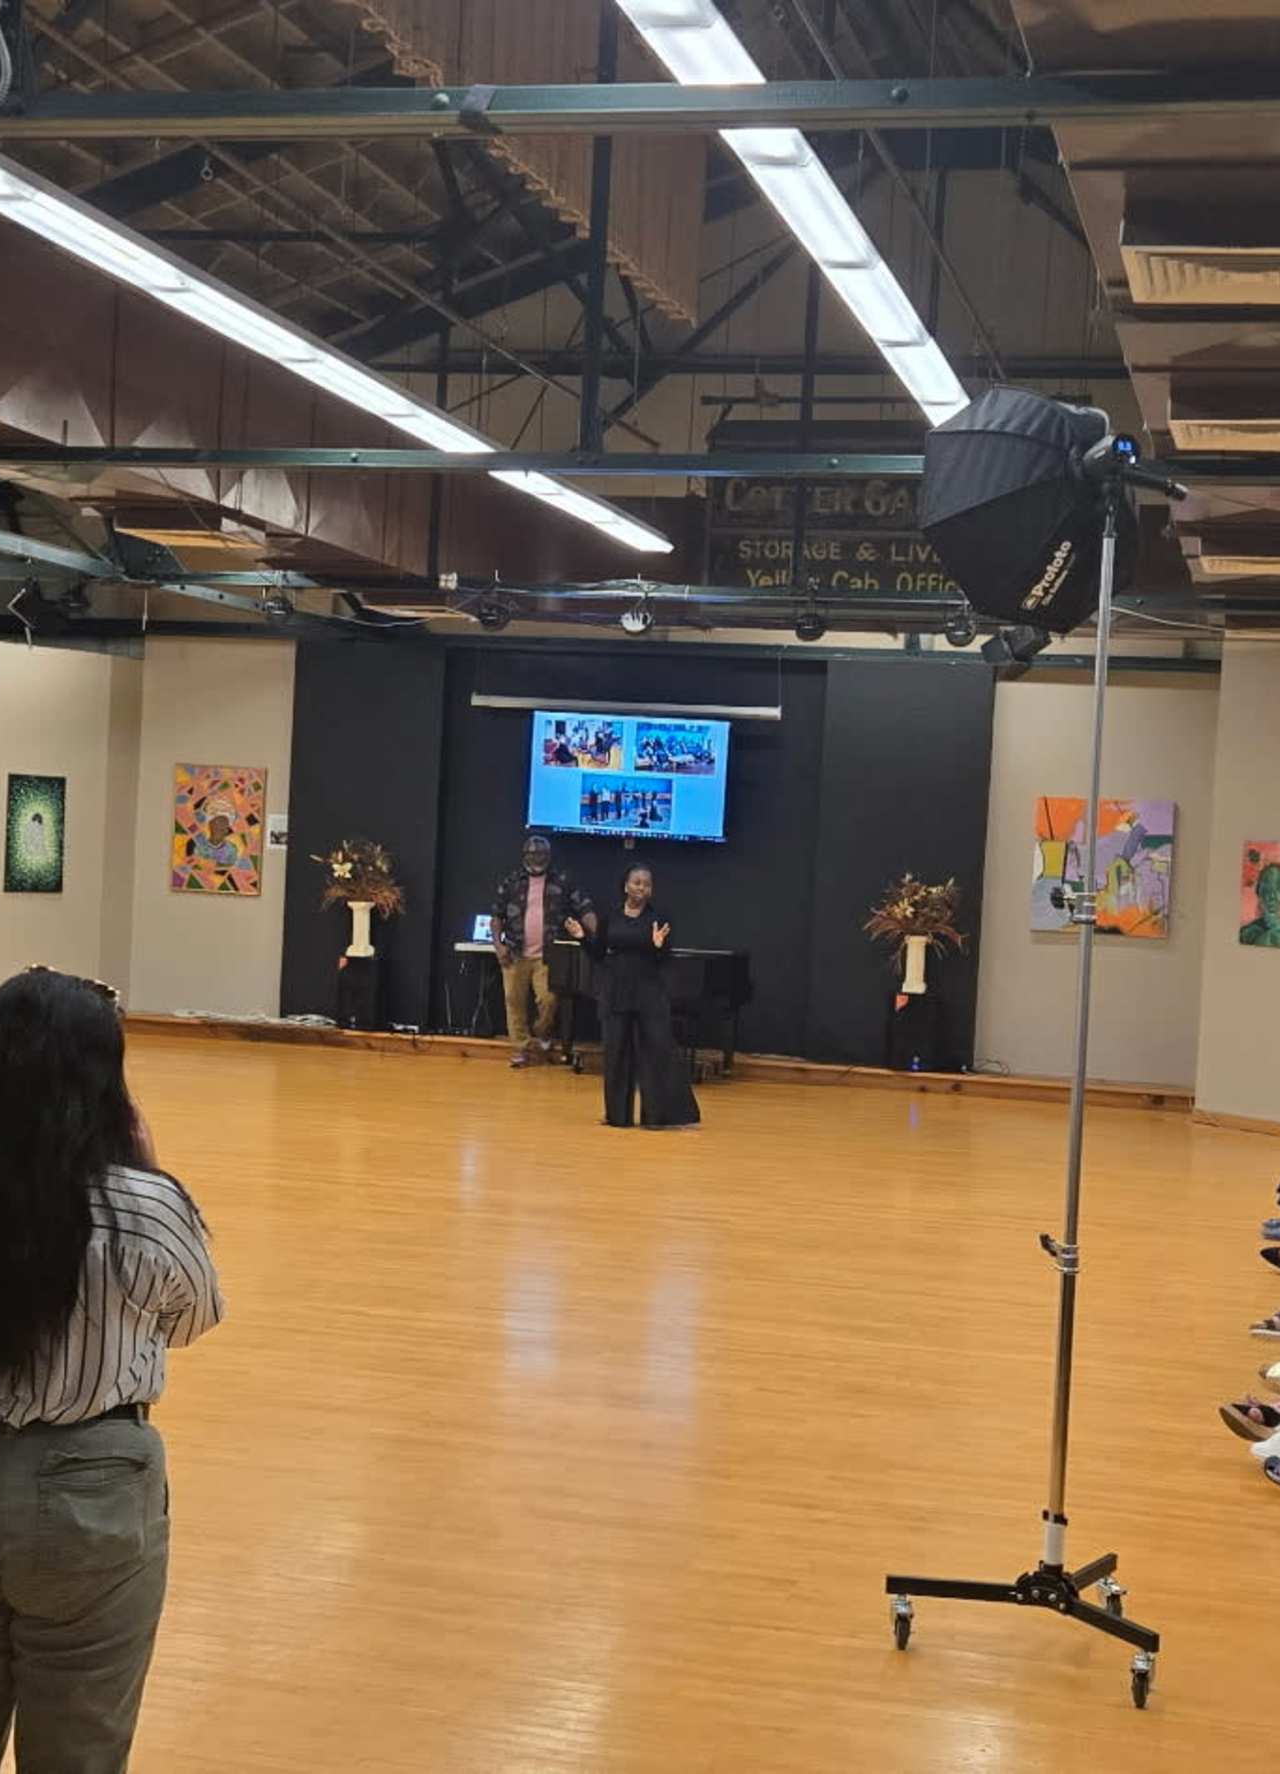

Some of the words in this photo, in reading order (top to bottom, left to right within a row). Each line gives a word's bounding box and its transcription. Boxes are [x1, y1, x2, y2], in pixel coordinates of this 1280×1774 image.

[724, 478, 853, 514] COTER
[738, 539, 842, 561] STORAGE
[855, 541, 881, 562] &
[890, 543, 942, 563] LIV
[746, 568, 820, 588] Yell
[831, 570, 880, 590] Cab
[1031, 540, 1072, 598] Profoto
